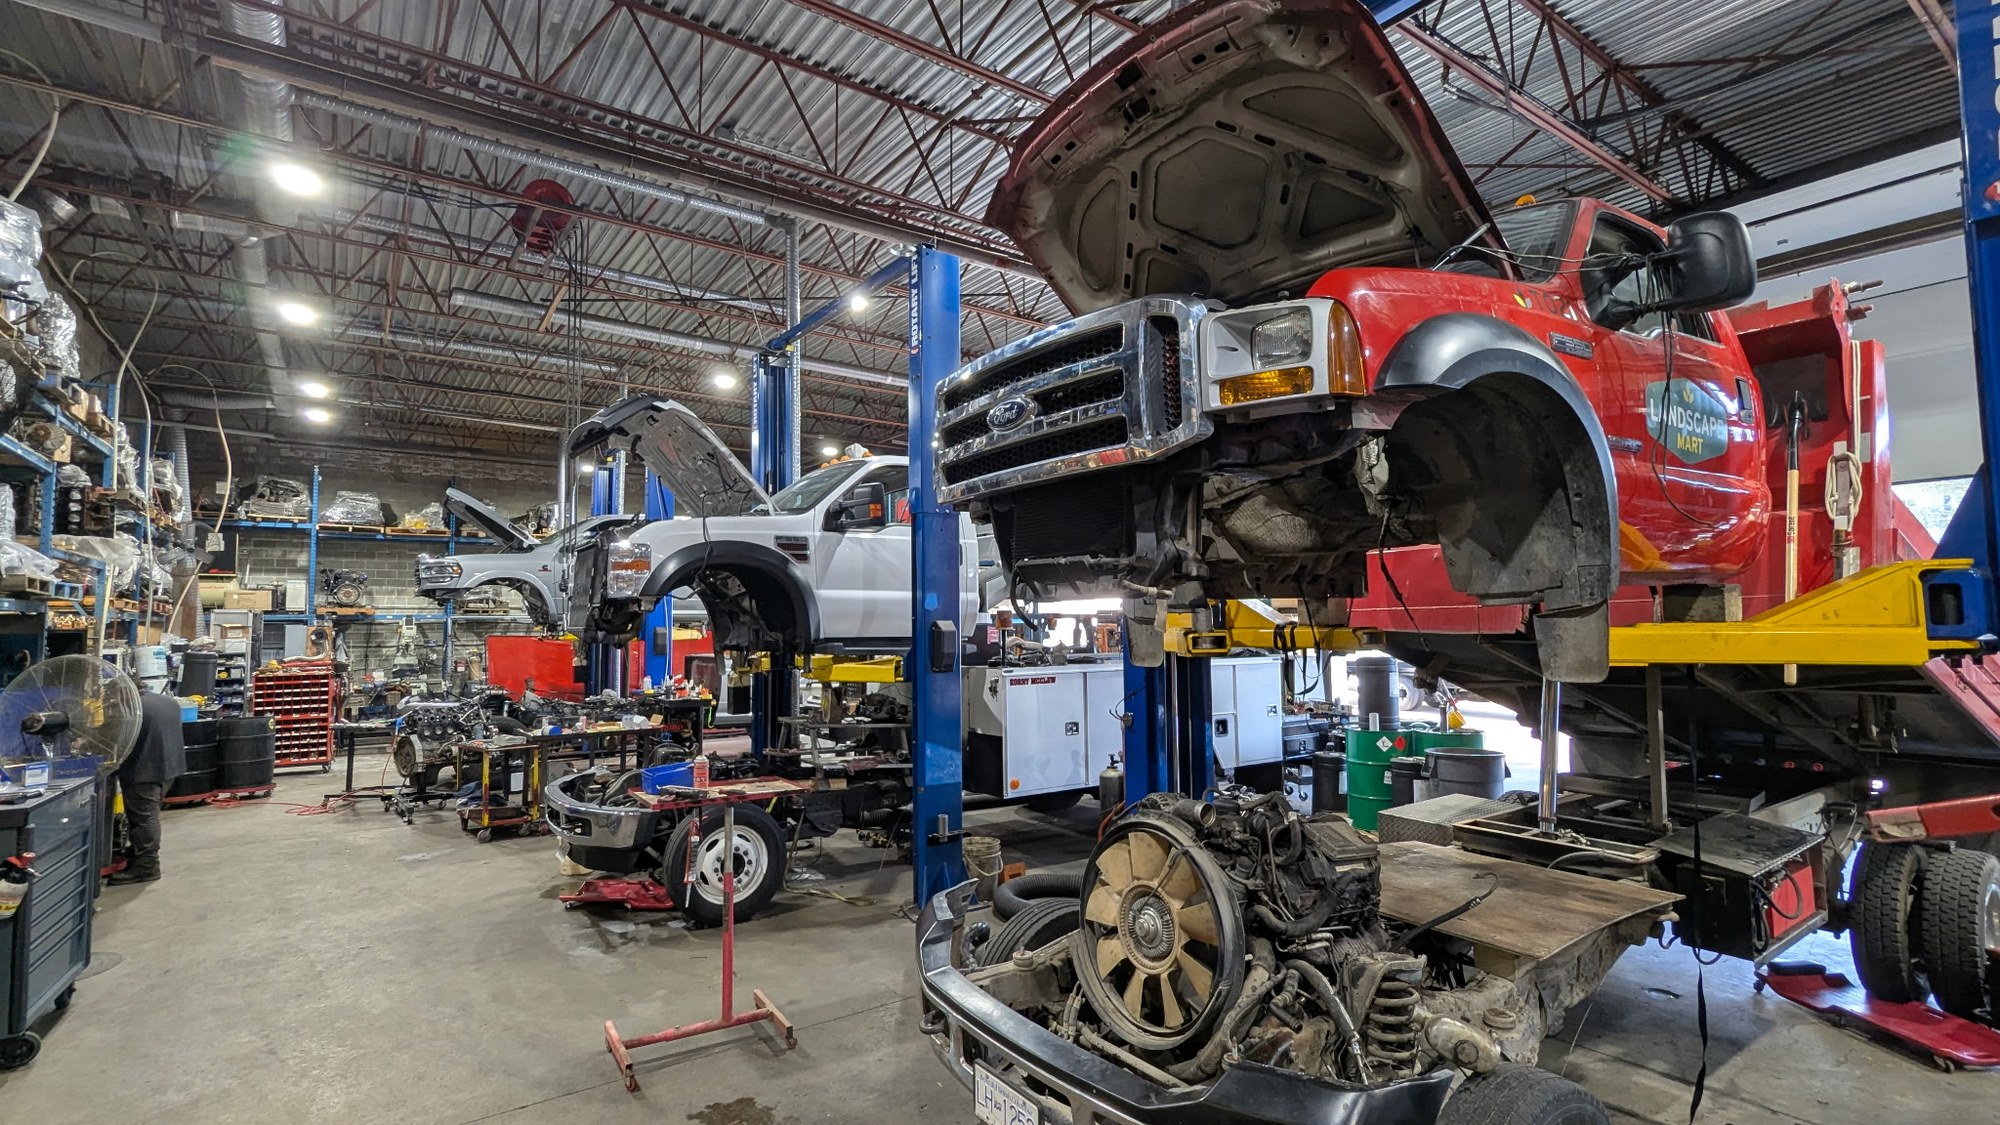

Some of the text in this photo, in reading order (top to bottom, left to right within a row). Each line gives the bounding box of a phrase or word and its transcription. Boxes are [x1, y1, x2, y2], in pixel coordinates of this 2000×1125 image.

[911, 288, 919, 348] ROTARY
[993, 402, 1019, 425] Ford
[1677, 432, 1704, 455] MART
[976, 1079, 994, 1113] LH
